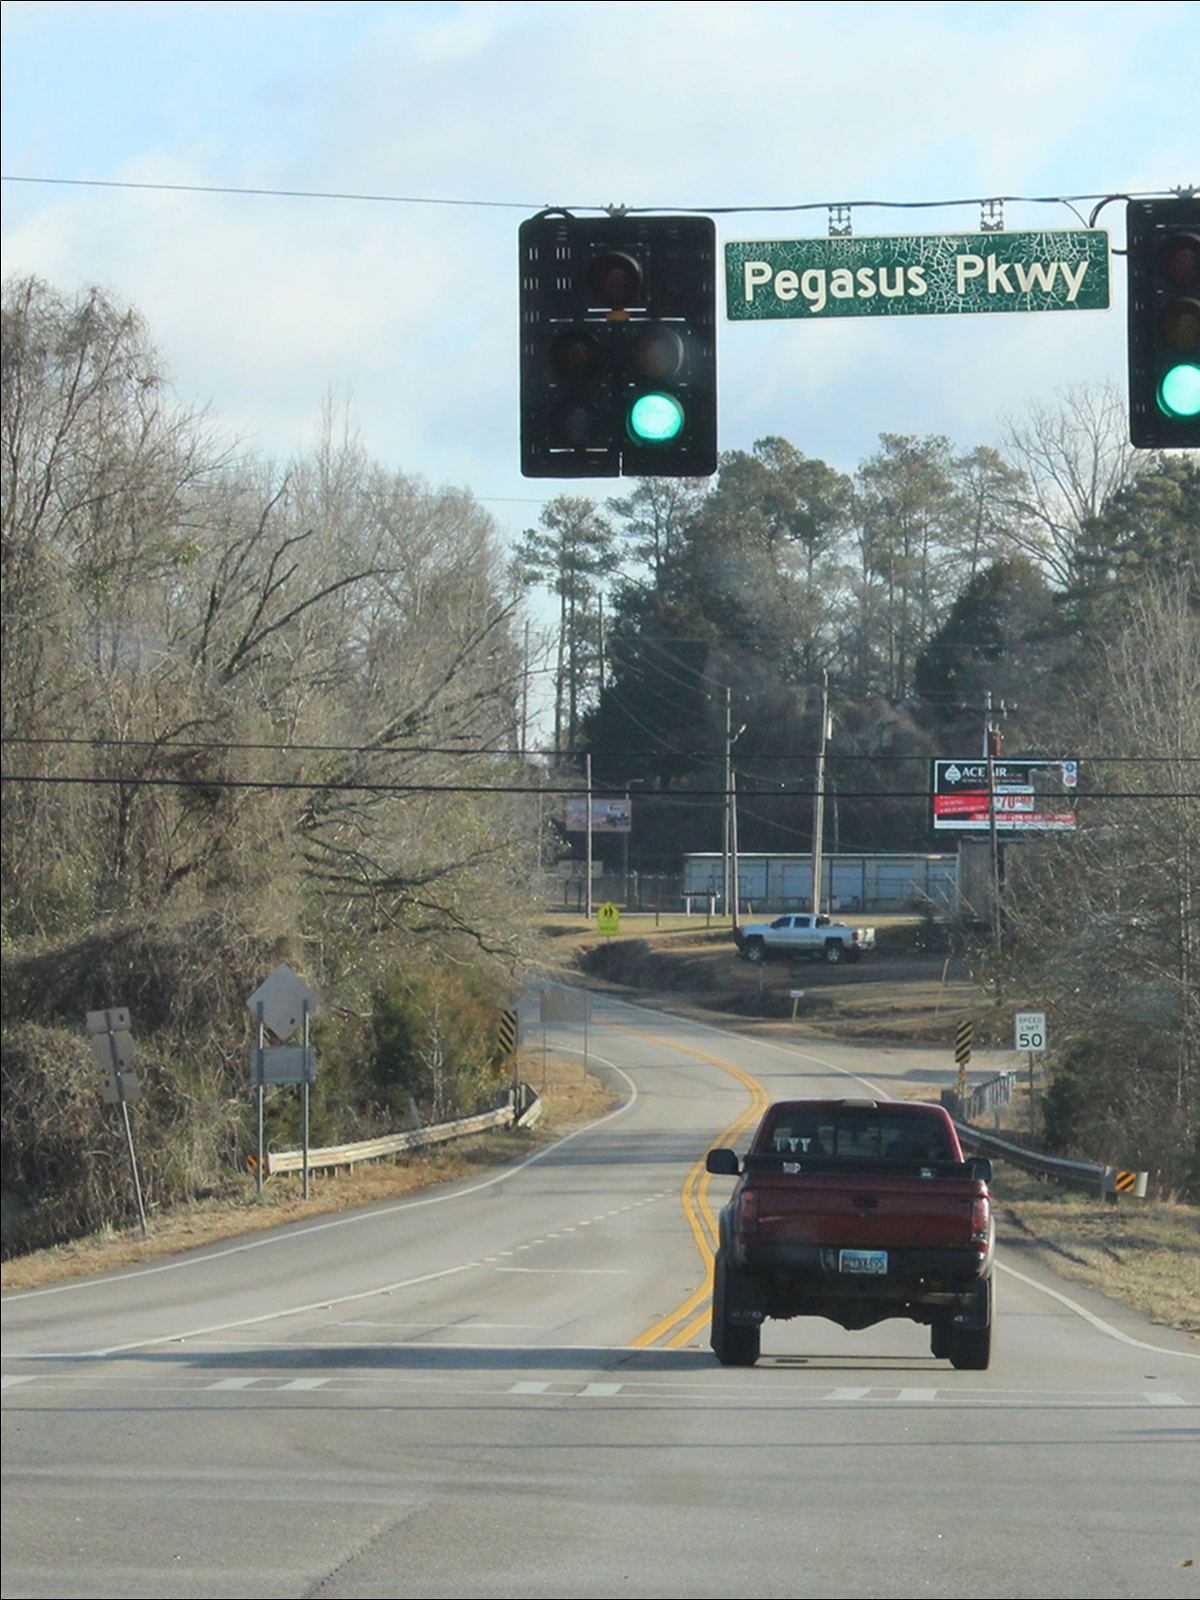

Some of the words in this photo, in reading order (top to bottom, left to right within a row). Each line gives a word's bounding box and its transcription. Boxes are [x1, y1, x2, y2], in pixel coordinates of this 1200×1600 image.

[743, 261, 928, 313] Pegasus
[955, 252, 1089, 302] Pkwy
[961, 766, 986, 777] ACE
[1019, 1033, 1043, 1047] 50
